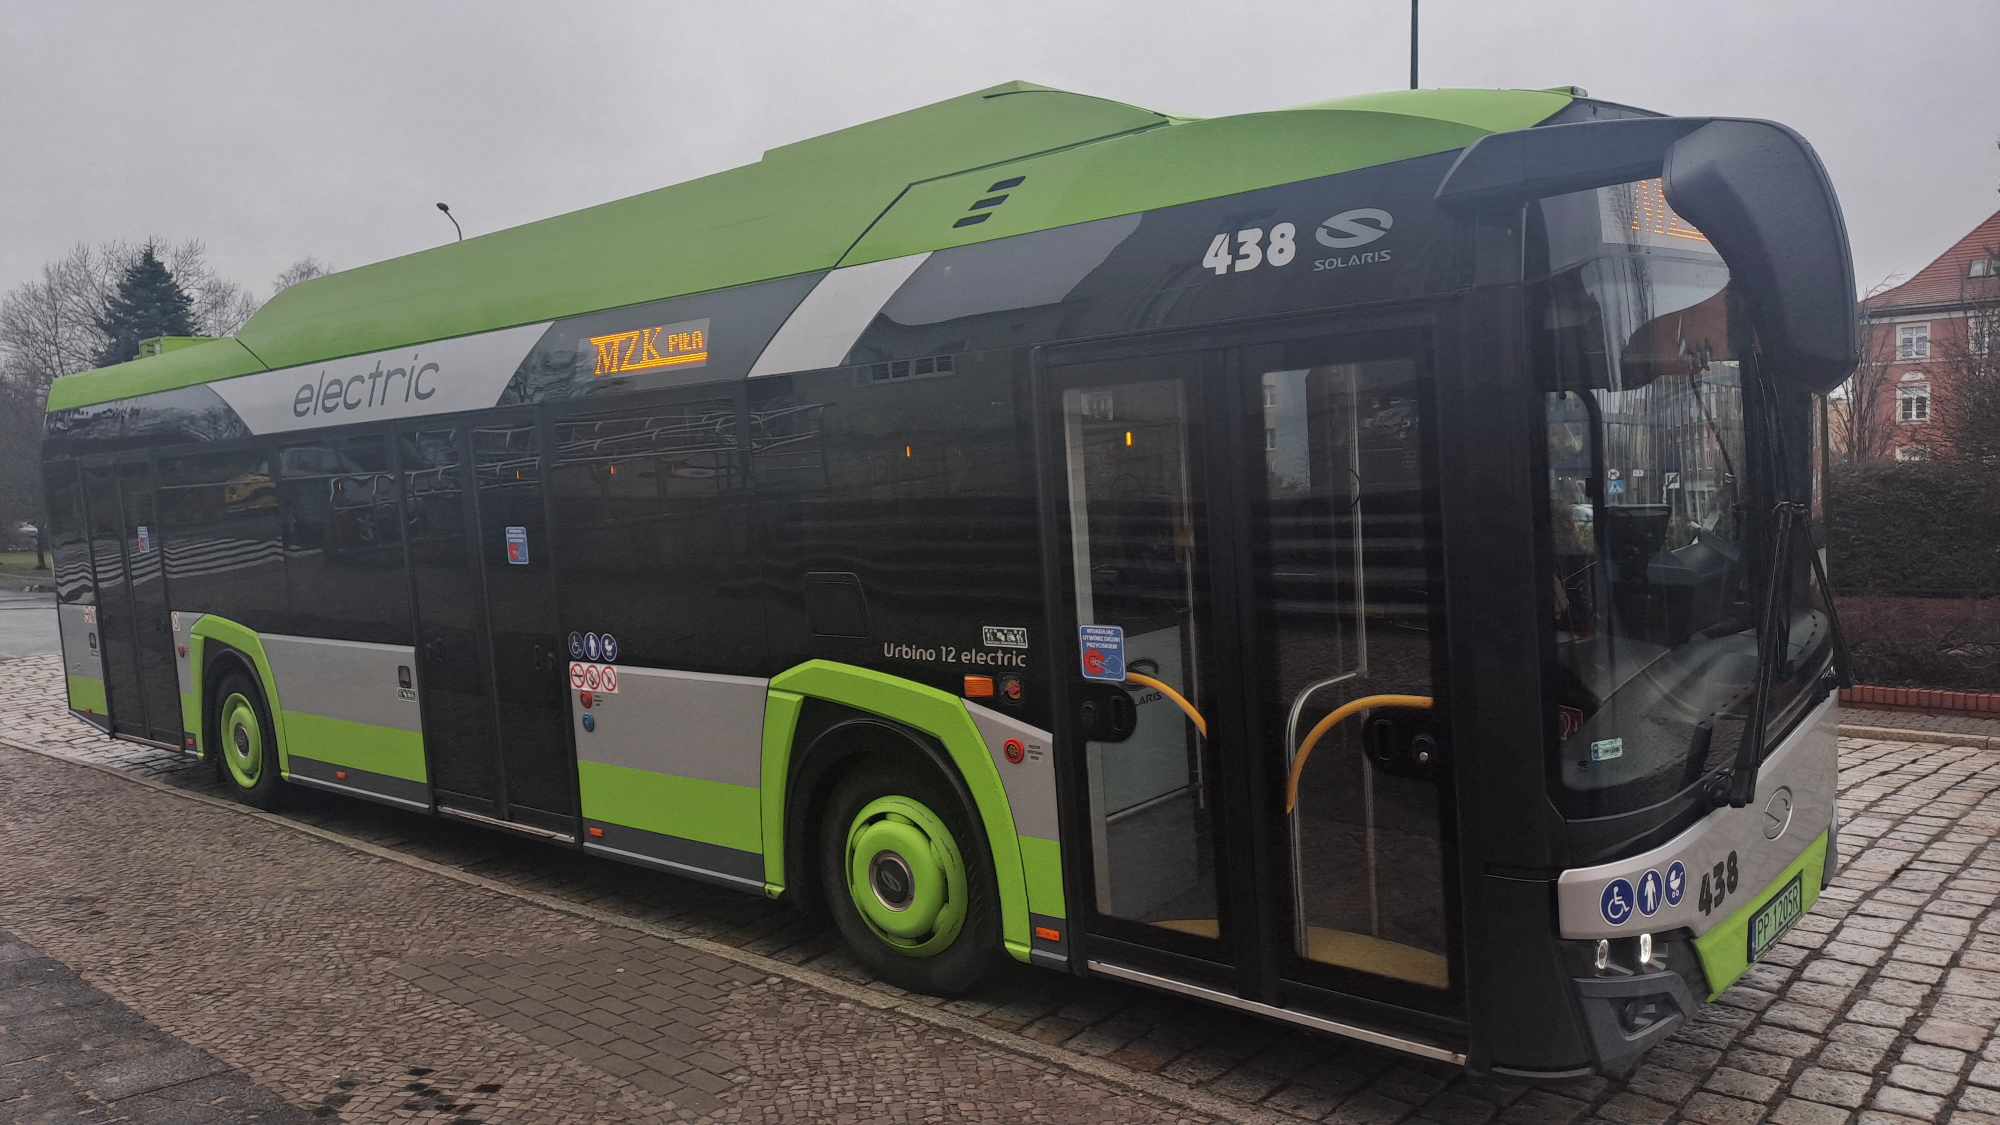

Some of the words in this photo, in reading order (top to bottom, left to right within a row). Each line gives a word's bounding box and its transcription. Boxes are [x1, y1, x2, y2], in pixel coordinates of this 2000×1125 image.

[1202, 222, 1296, 275] 438
[1313, 249, 1391, 271] SOLARIS
[591, 327, 662, 375] MZK
[293, 353, 440, 418] electric
[883, 642, 936, 661] Urbino
[940, 646, 956, 662] 12
[961, 648, 1027, 667] electric
[1698, 850, 1738, 916] 438
